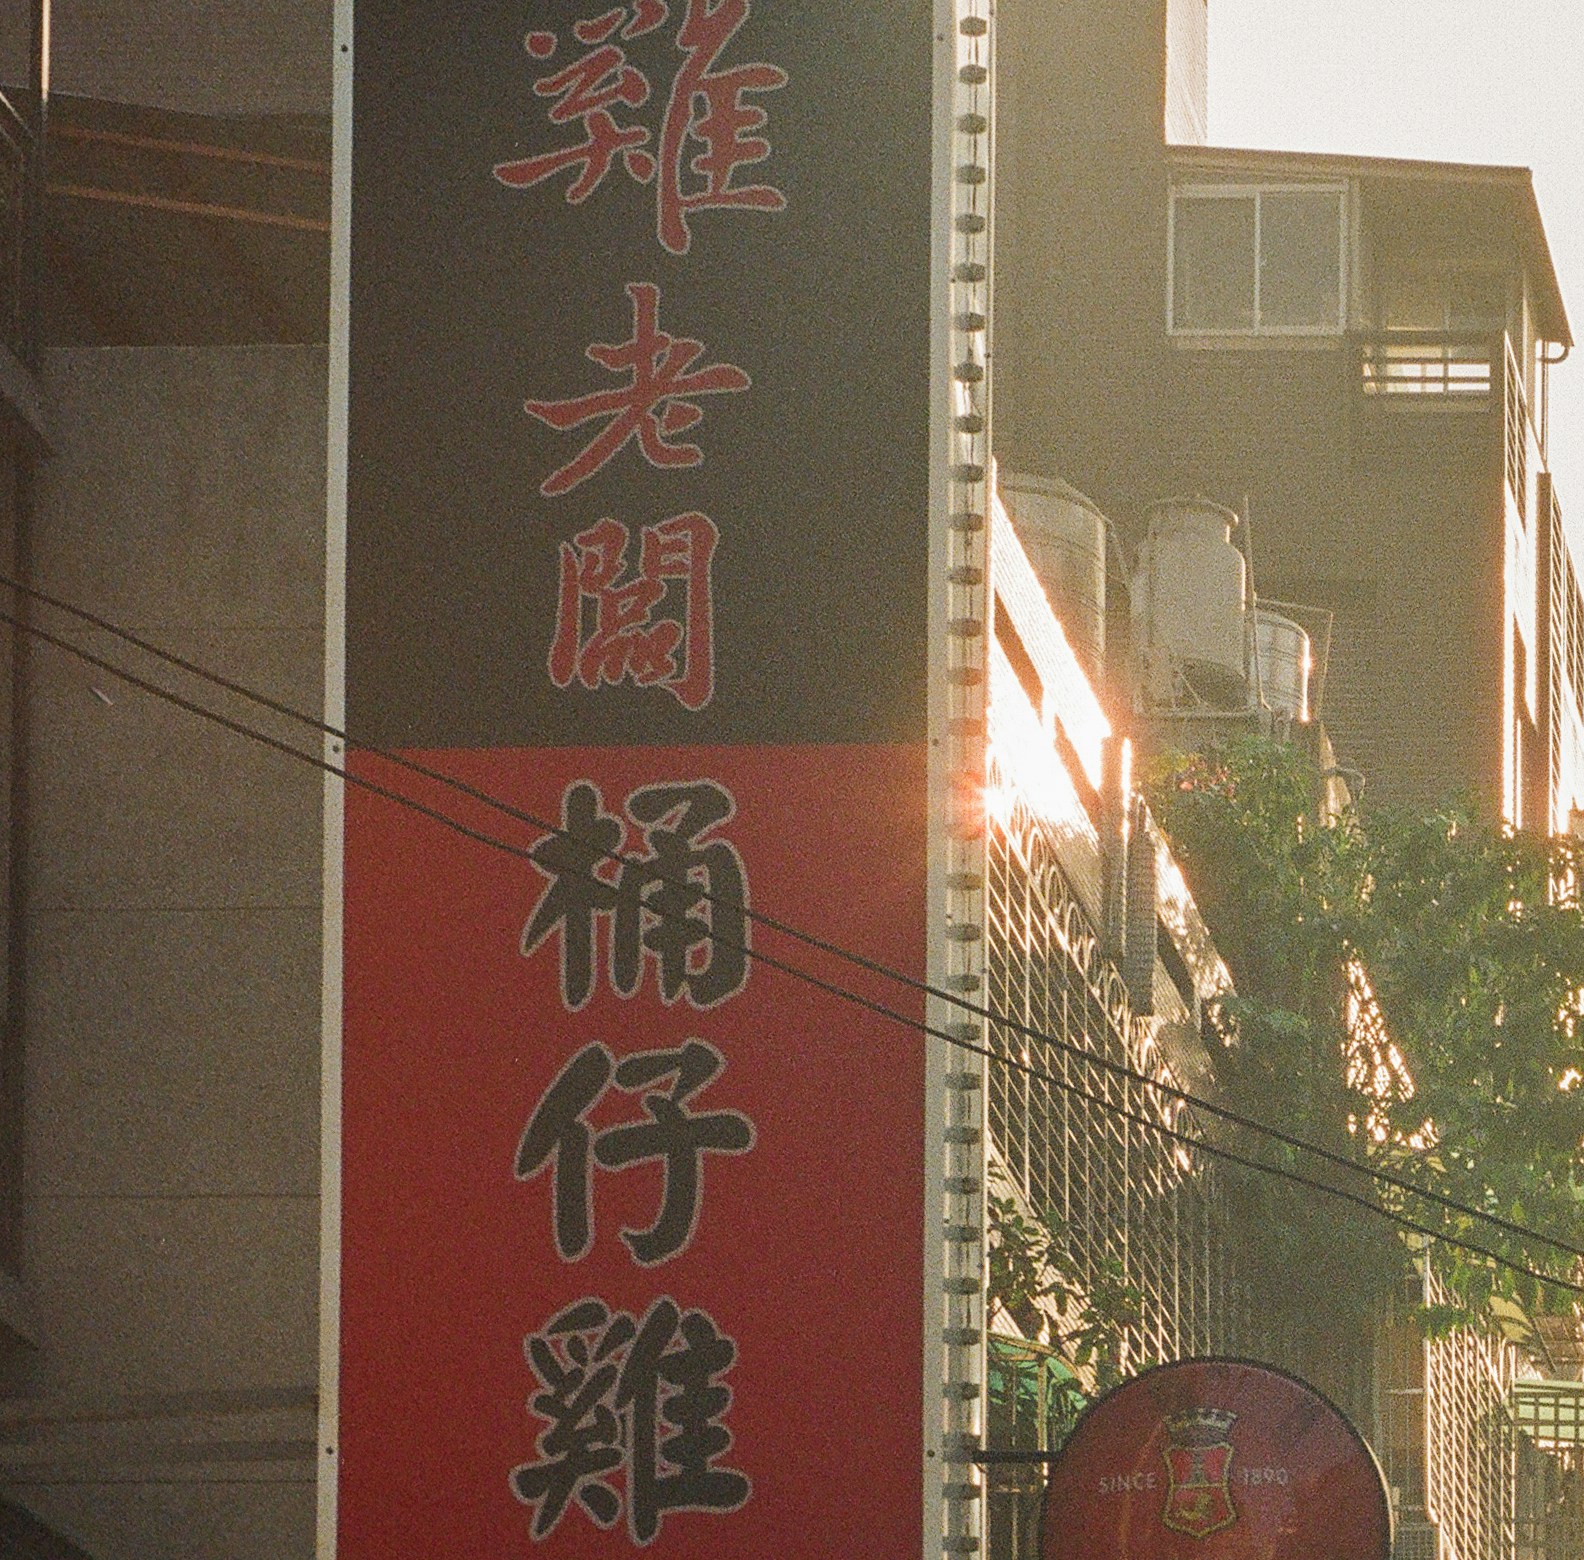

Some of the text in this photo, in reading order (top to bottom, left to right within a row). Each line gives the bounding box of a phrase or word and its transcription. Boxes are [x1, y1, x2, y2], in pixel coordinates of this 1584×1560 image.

[508, 776, 758, 1547] 桶仔雞
[1098, 1471, 1158, 1495] SINCE
